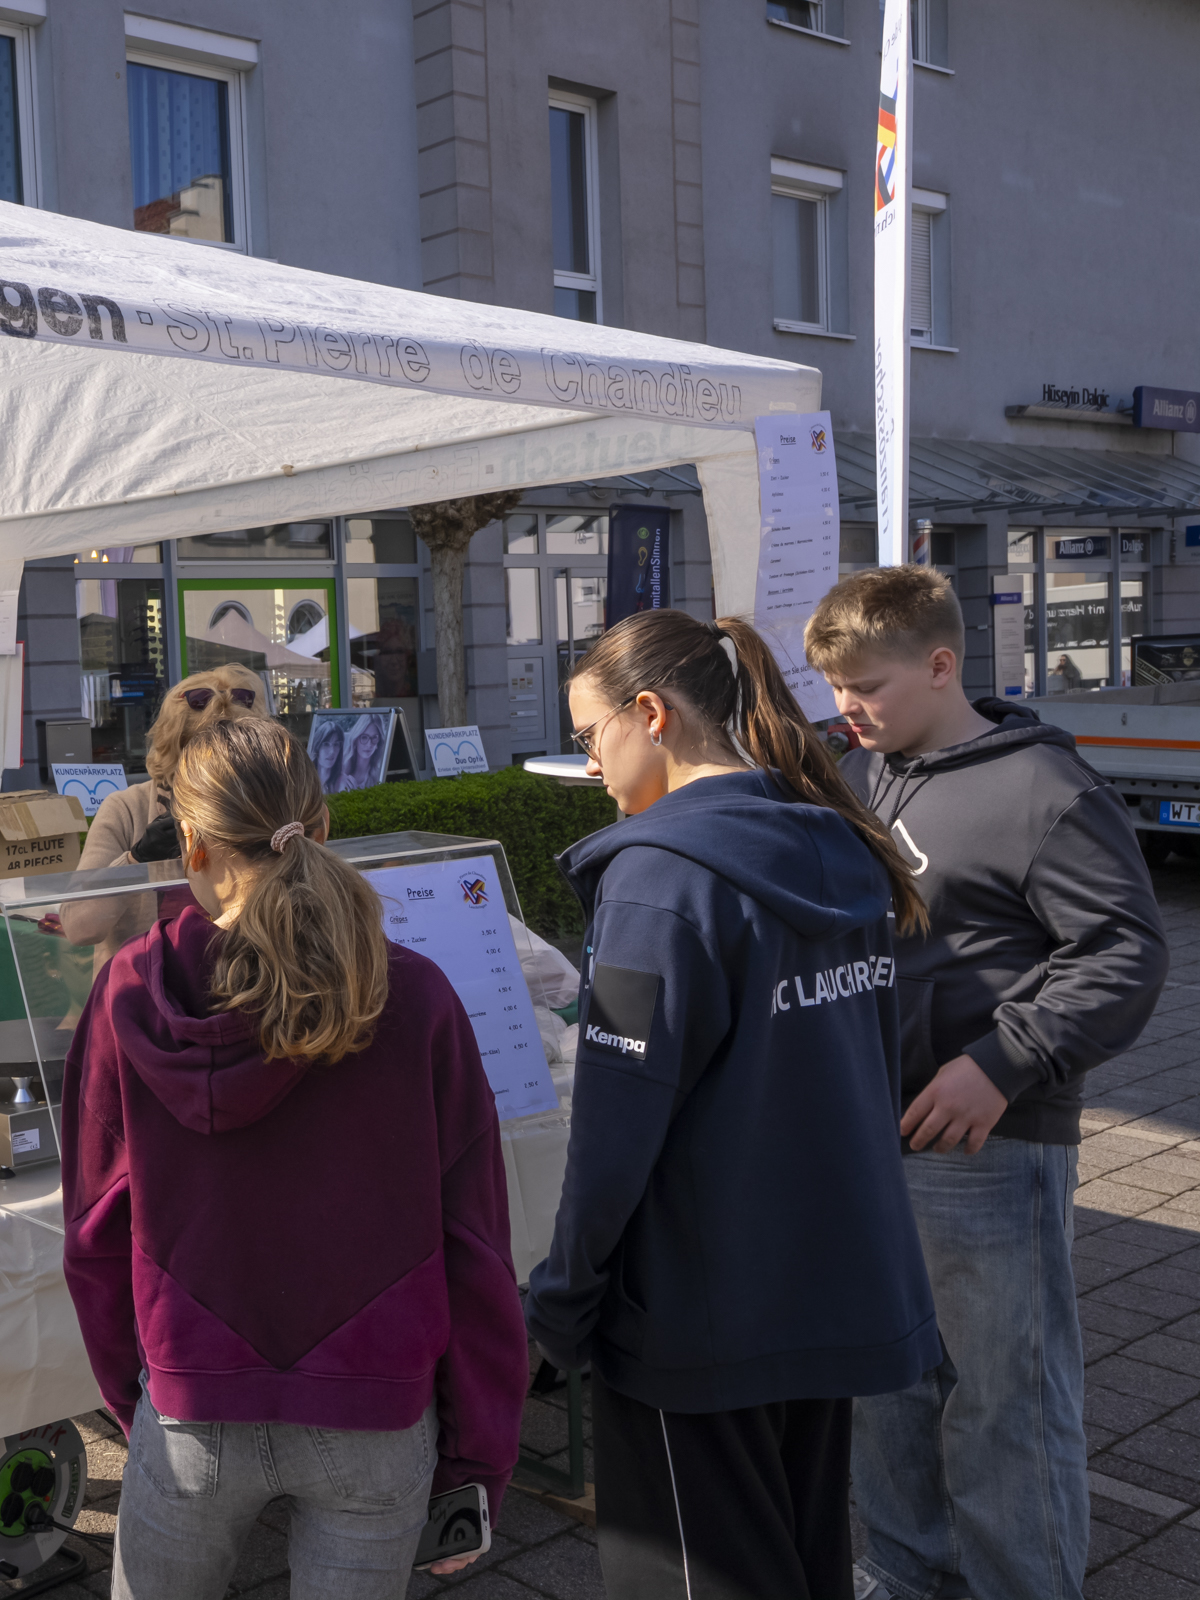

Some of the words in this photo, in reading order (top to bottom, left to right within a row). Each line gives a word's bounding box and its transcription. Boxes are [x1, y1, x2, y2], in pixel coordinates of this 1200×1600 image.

[460, 338, 522, 395] de
[541, 347, 743, 424] Chandieu
[1153, 399, 1184, 418] Allianz
[780, 434, 796, 445] Preise
[1059, 541, 1085, 555] Allianz
[650, 528, 661, 611] mitallenSinnen
[54, 768, 123, 776] KUNDENPARKPLATZ
[1171, 803, 1196, 820] WT
[30, 838, 65, 853] FLUTE
[8, 860, 21, 870] 48
[24, 854, 64, 869] PIECES
[407, 887, 435, 900] Preise
[389, 915, 408, 924] Crêpes
[585, 1023, 646, 1054] Kempa
